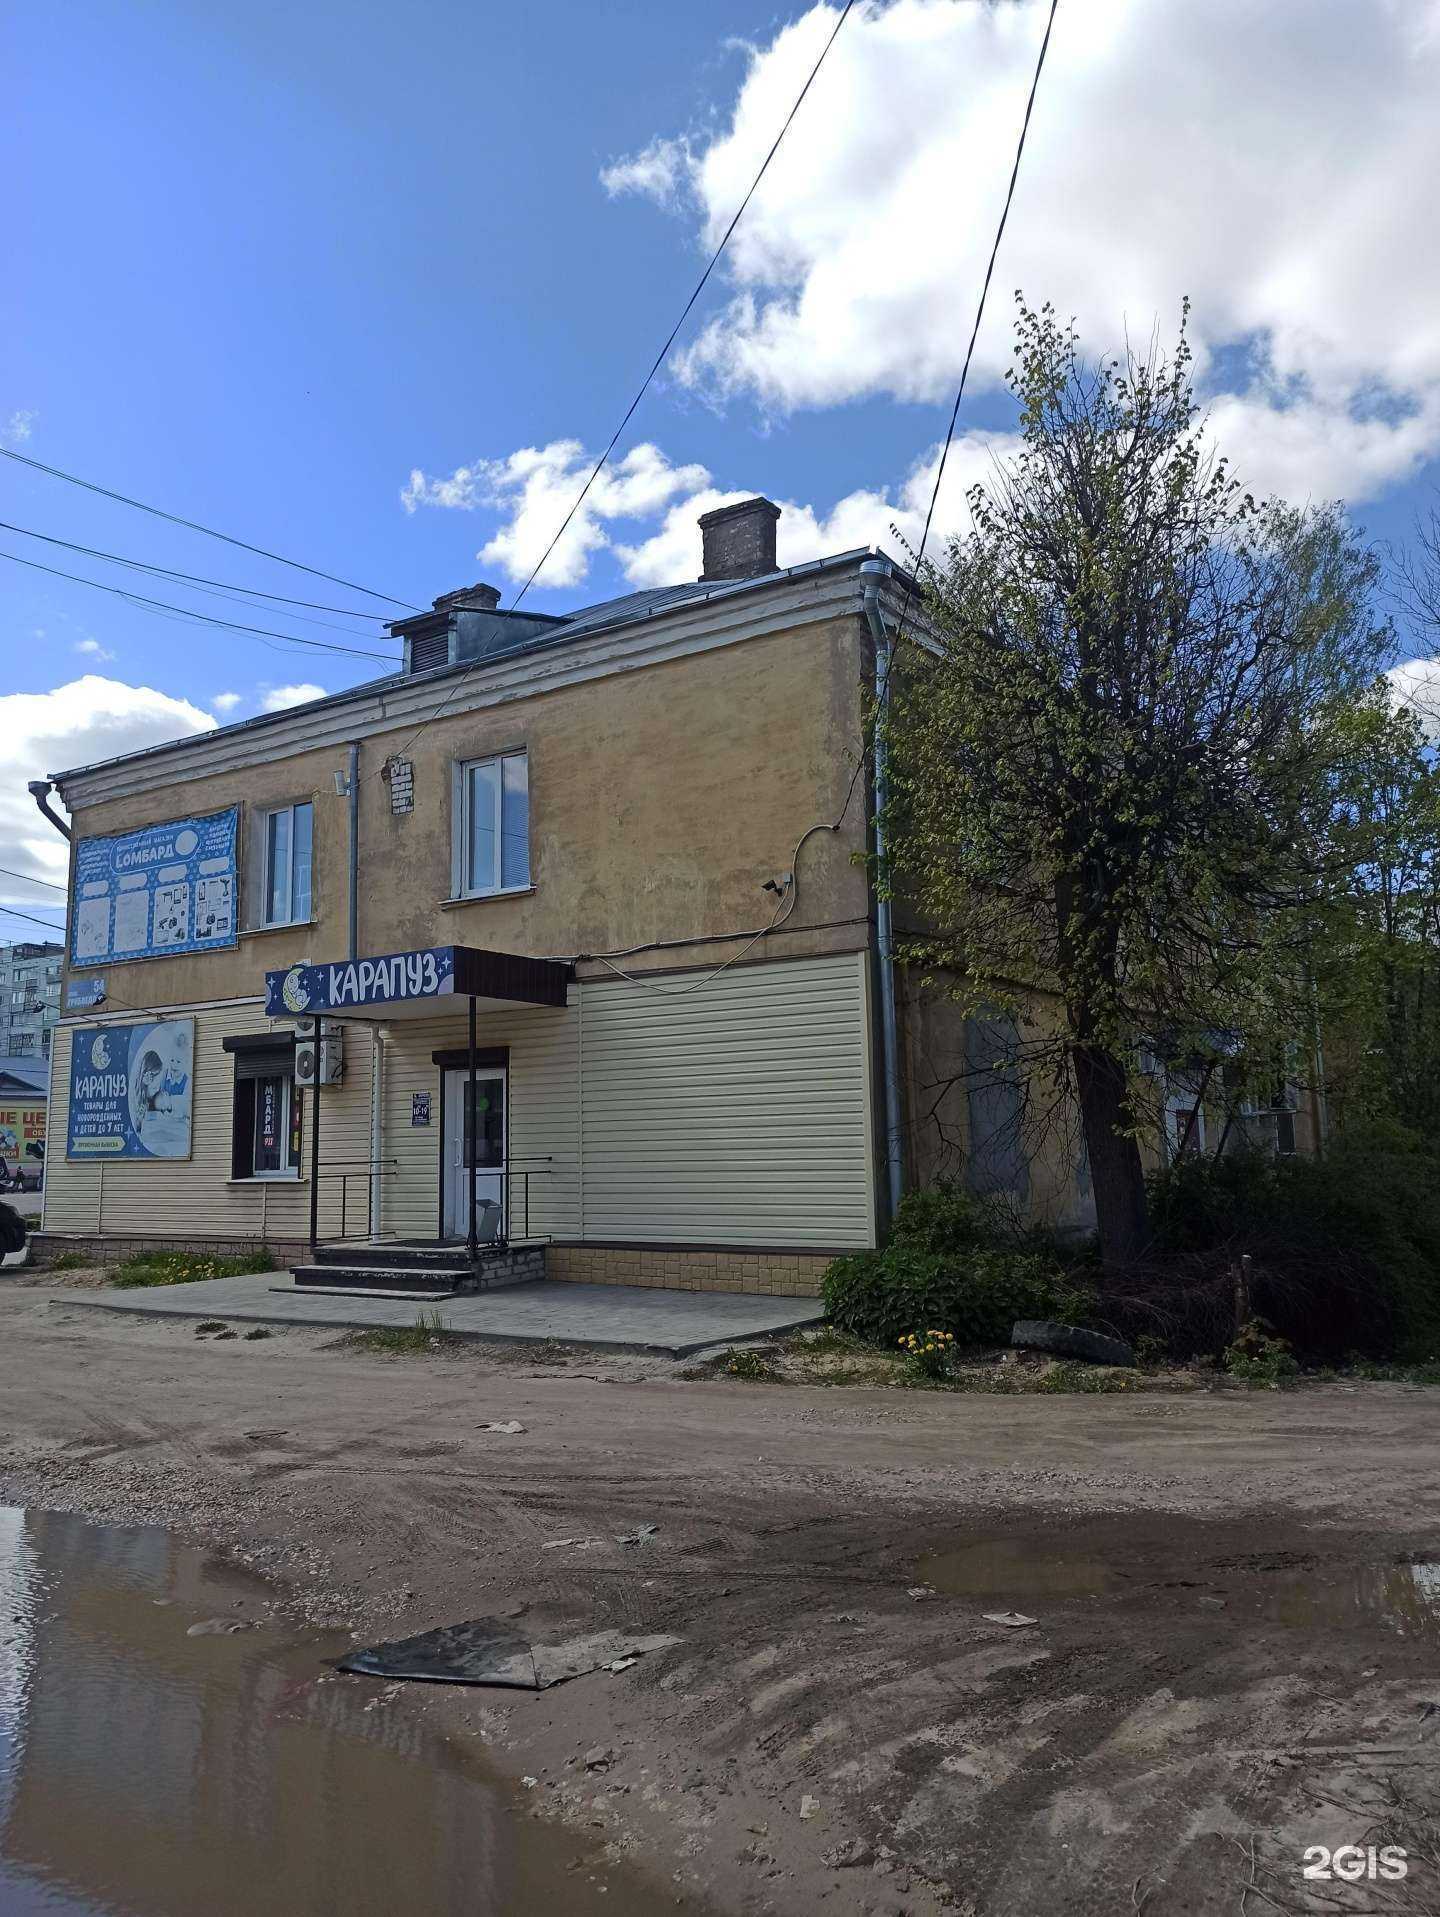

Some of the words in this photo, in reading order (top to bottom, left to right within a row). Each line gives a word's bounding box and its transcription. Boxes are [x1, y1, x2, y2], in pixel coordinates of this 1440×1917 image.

[328, 953, 439, 1006] КАРАПУЗ
[75, 1073, 128, 1100] КАРАПУЗ
[84, 1101, 104, 1110] ТОВАРЫ
[105, 1100, 117, 1111] ДЛЯ
[74, 1125, 79, 1133] И
[80, 1123, 97, 1135] ДЕТЕЙ
[97, 1124, 106, 1135] ДО
[113, 1123, 124, 1132] ЛЕТ
